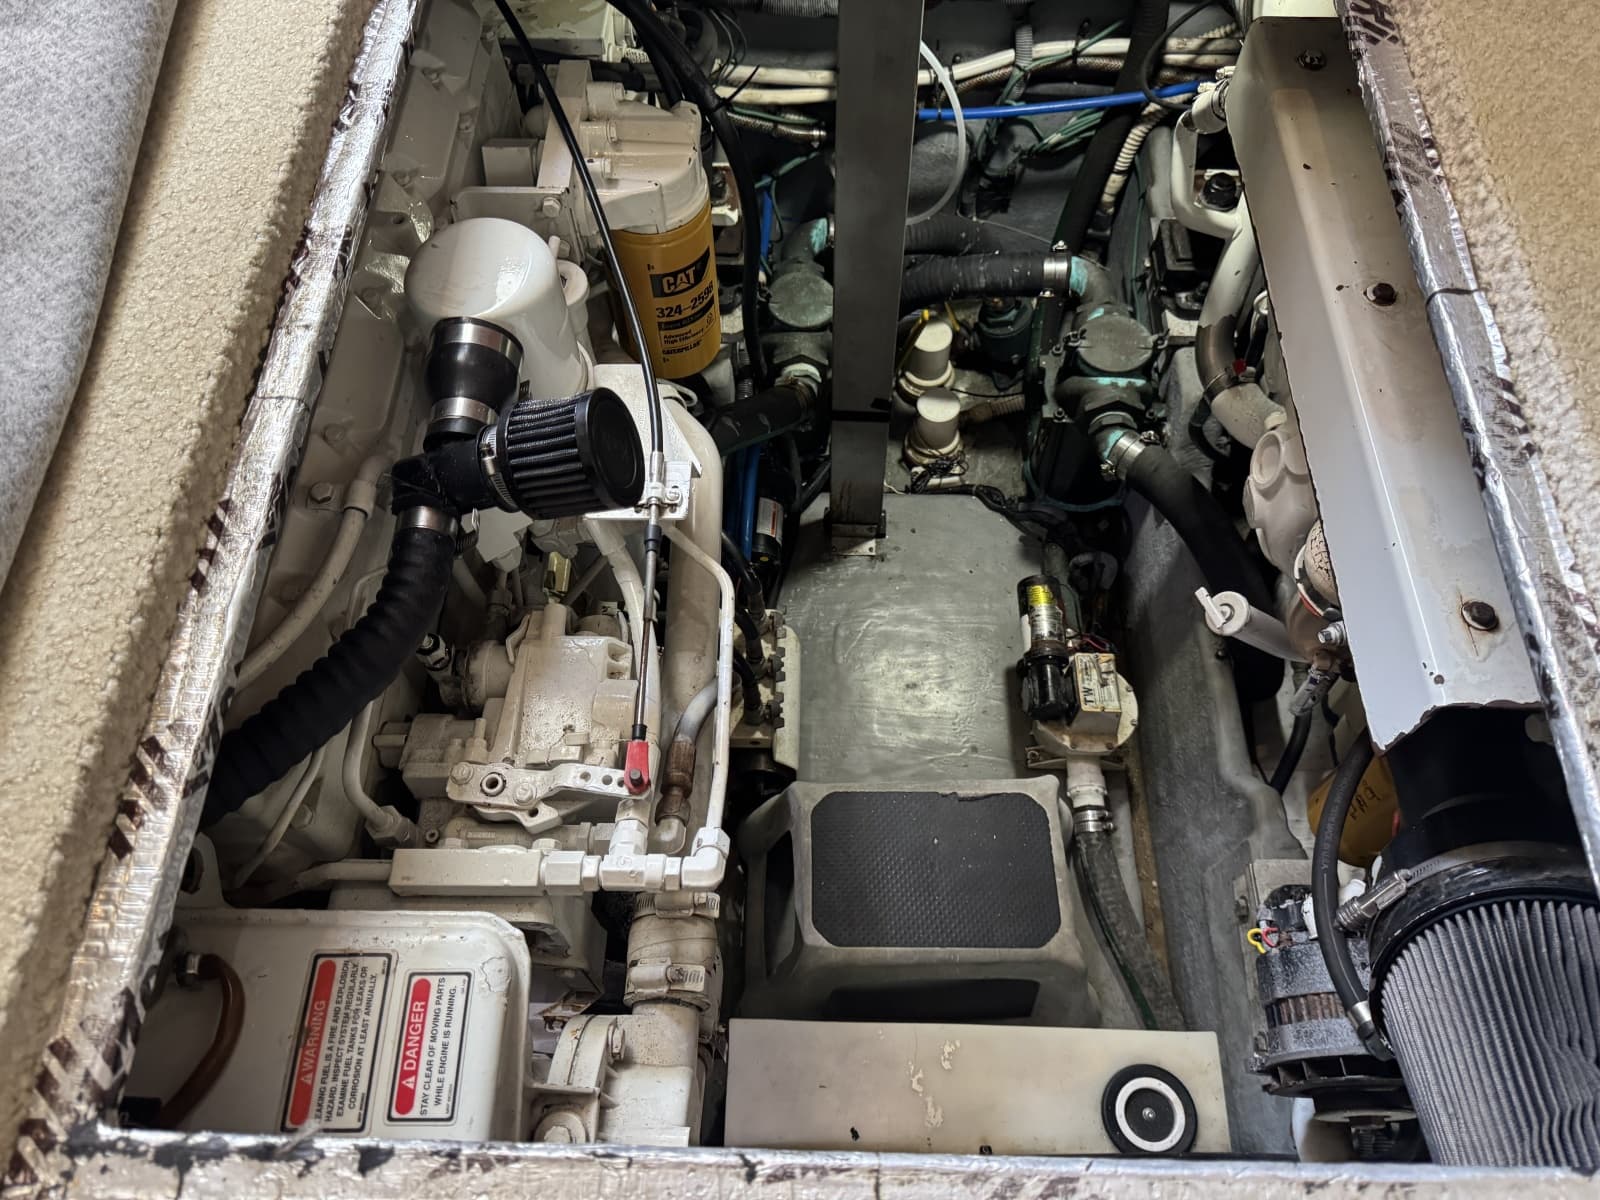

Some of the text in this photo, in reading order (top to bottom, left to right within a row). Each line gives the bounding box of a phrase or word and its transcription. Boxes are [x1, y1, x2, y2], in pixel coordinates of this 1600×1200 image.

[662, 267, 696, 293] CAT
[335, 961, 350, 1004] EXPLOSION
[355, 980, 366, 1006] LEAKS
[364, 973, 377, 1016] ANNUALLY.
[435, 977, 446, 1005] PARTS
[332, 1007, 342, 1022] AND
[352, 1008, 362, 1024] FOR
[444, 986, 457, 1028] RUNNING.
[302, 1000, 326, 1071] WARNING
[328, 1026, 338, 1043] FIRE
[359, 1019, 370, 1043] LEAST
[404, 1001, 425, 1070] DANGER
[430, 1008, 441, 1042] MOVING
[347, 1027, 358, 1053] TANKS
[326, 1084, 338, 1121] HAZARD.
[332, 1047, 344, 1081] INSPECT
[339, 1012, 351, 1044] SYSTEM
[343, 1056, 353, 1077] FUEL
[438, 1041, 449, 1074] ENGINE
[321, 1064, 331, 1084] FUEL
[348, 1059, 363, 1109] CORROSION
[423, 1060, 434, 1090] CLEAR
[336, 1080, 349, 1116] EXAMINE
[420, 1093, 430, 1115] STAY
[434, 1077, 445, 1105] WHILE
